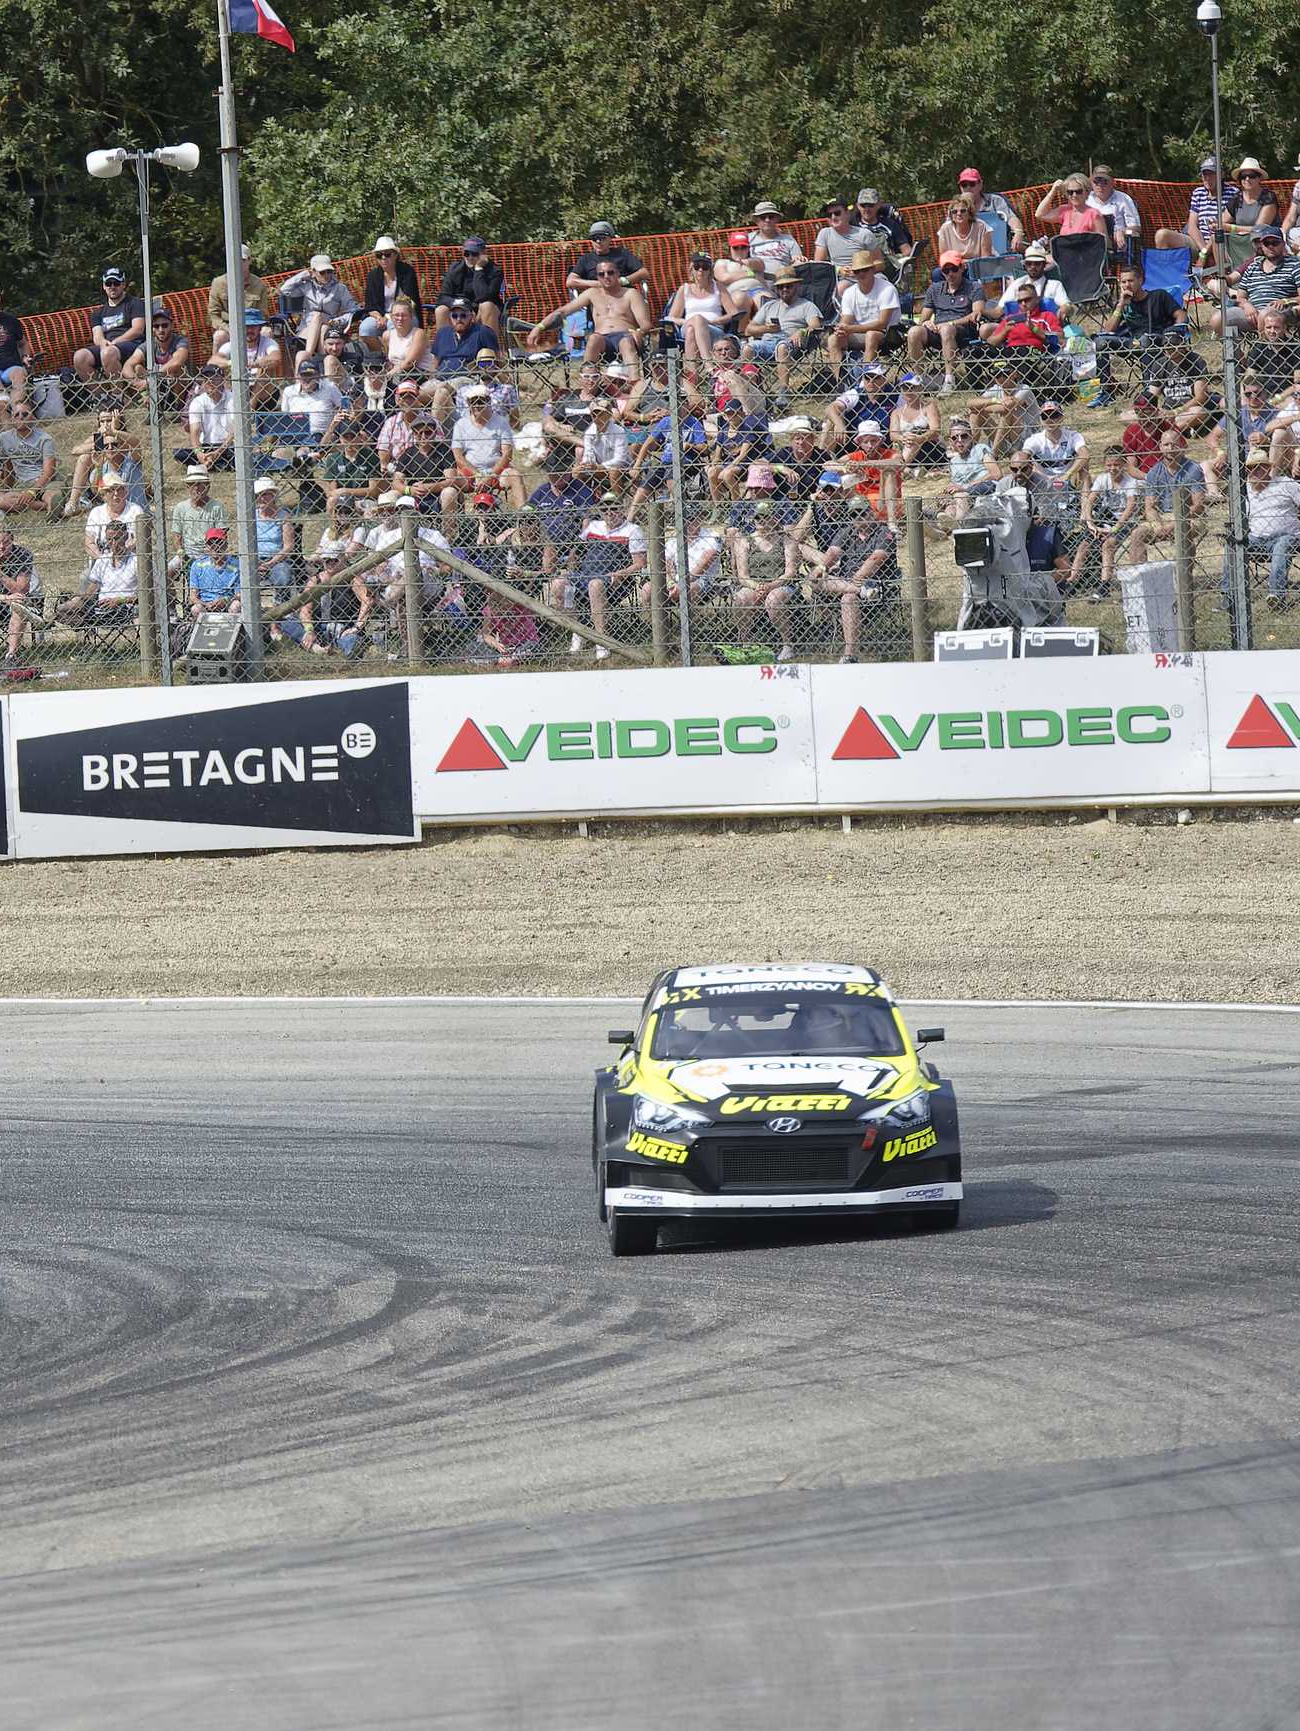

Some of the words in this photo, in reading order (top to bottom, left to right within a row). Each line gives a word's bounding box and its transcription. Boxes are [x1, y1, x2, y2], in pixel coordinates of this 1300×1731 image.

[486, 717, 777, 762] VEIDEC
[877, 706, 1173, 751] VEIDEC
[82, 745, 338, 790] BRETAGNE
[705, 982, 841, 996] TIMERZYANOV
